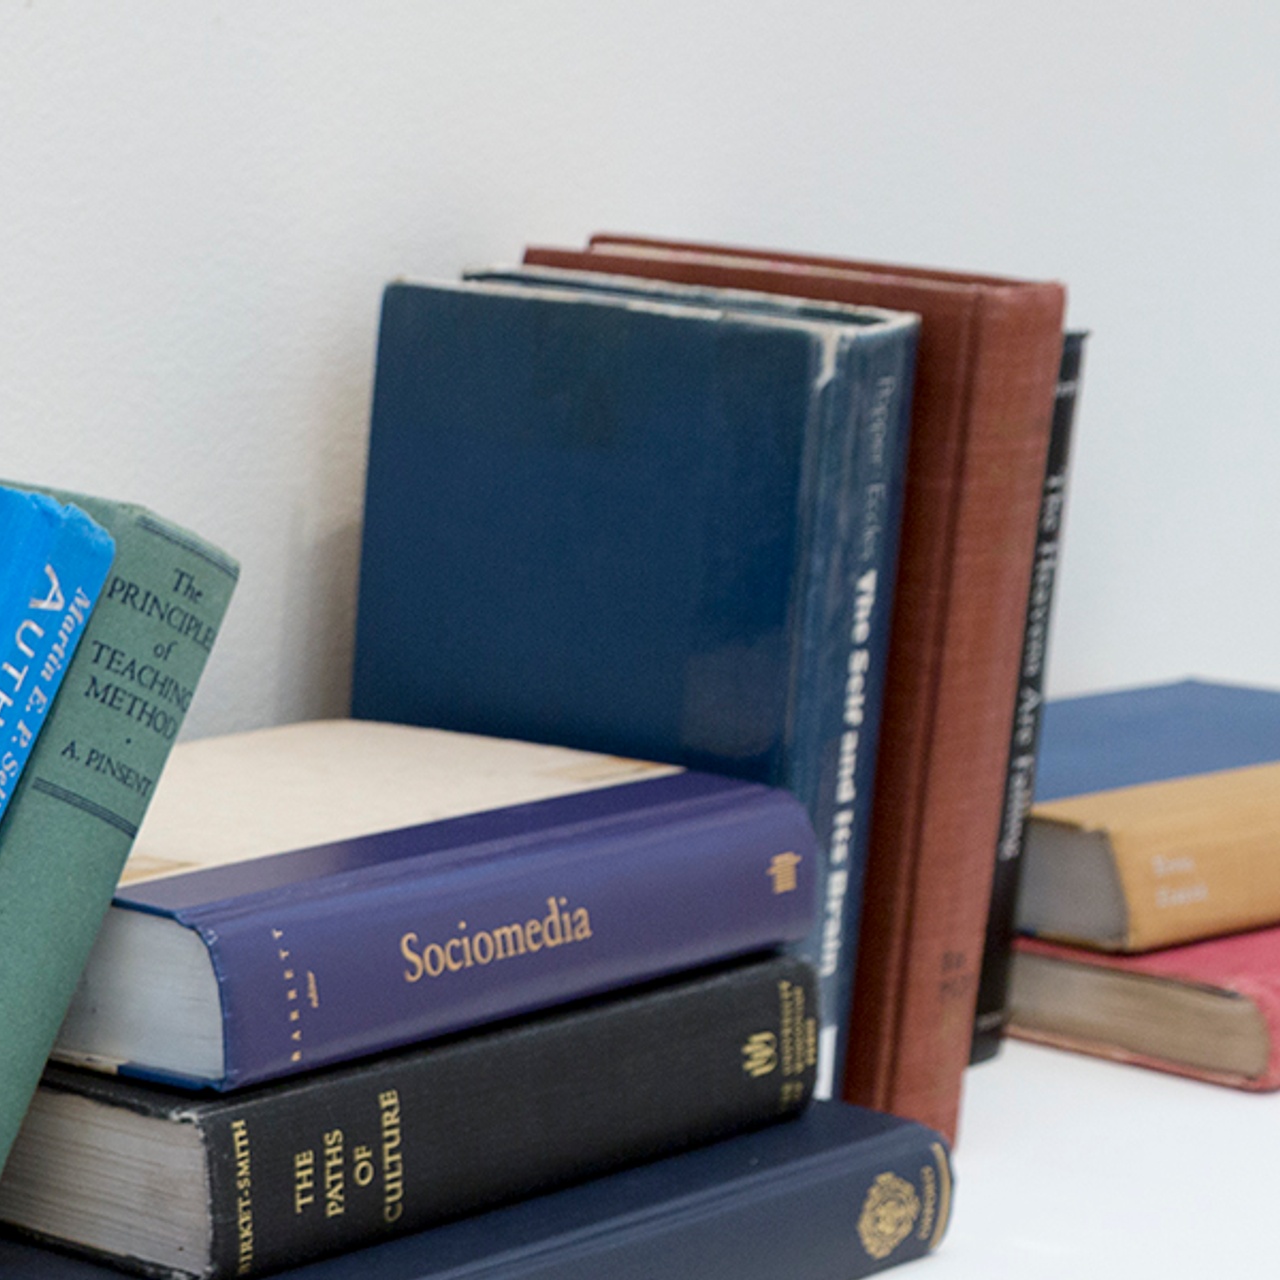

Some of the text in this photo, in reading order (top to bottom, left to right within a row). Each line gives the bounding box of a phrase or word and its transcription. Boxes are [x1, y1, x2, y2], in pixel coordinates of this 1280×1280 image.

[173, 567, 203, 604] The
[41, 586, 91, 682] Martin
[152, 640, 178, 662] of
[25, 685, 48, 714] E.
[83, 674, 178, 741] METHOD
[91, 639, 194, 714] TEACHING
[11, 719, 33, 748] P.
[60, 740, 152, 797] A. PINSENT
[820, 569, 877, 977] The Self and Its Brain
[400, 896, 594, 983] Sociomedia
[295, 1149, 316, 1214] THE
[323, 1129, 345, 1218] PATHS
[353, 1145, 374, 1187] OF
[377, 1089, 404, 1223] CULTURE
